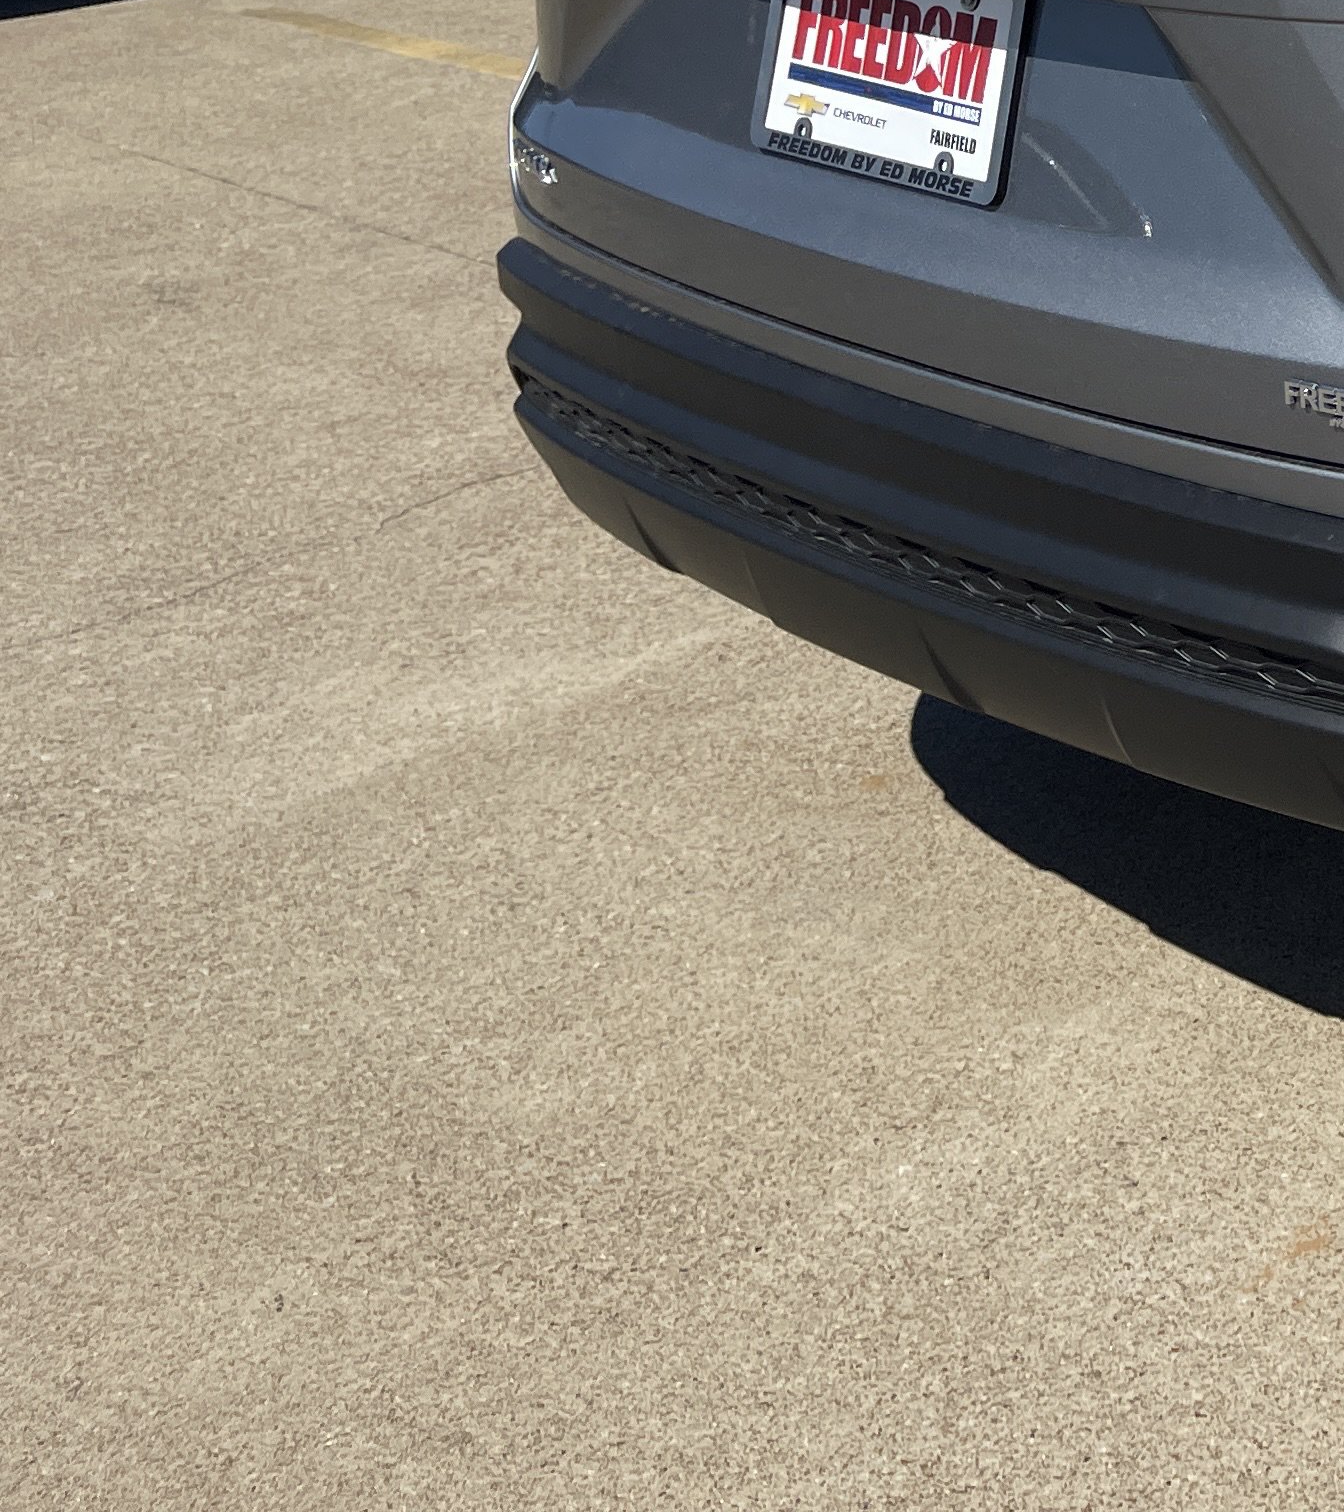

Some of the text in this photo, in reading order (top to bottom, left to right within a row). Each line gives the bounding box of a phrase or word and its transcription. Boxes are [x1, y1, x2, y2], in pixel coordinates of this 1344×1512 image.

[833, 107, 887, 130] CHEVROLET
[932, 100, 980, 123] BY ED MORSE
[929, 128, 977, 155] FAIRFIELD
[768, 131, 974, 198] FREEDOM BY ED MORSE
